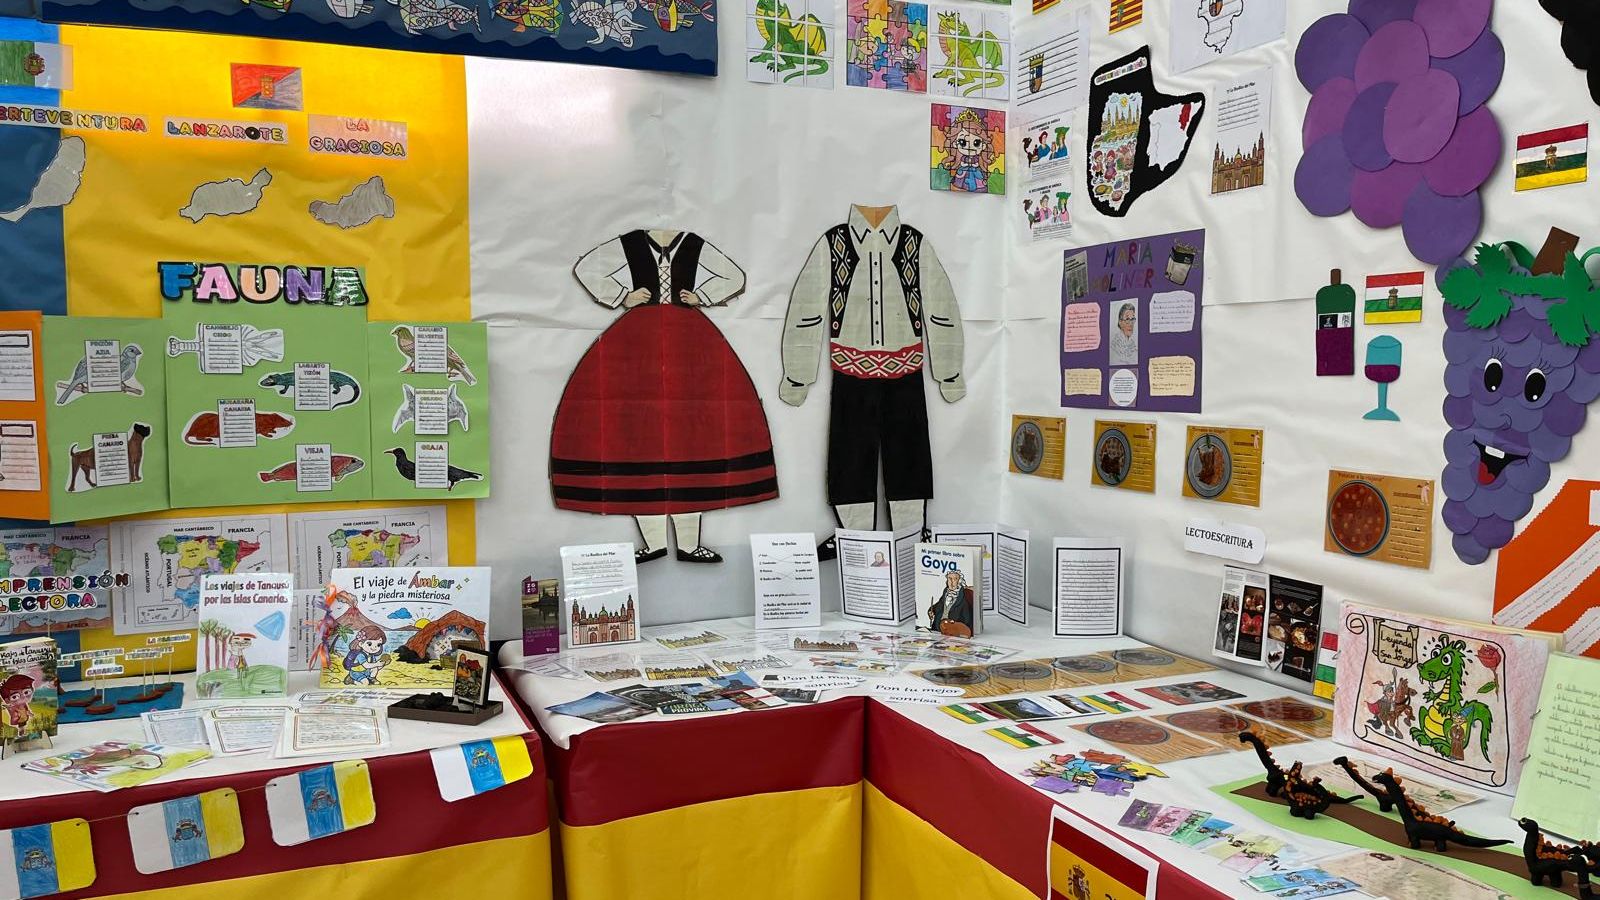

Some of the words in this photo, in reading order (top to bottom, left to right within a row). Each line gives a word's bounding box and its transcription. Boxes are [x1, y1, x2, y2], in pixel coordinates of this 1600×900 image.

[167, 121, 284, 142] LANZAROTE
[346, 117, 370, 132] LA
[309, 136, 406, 157] GRACIOSA
[158, 262, 369, 307] FAUNA
[304, 447, 324, 455] VIEJA
[1185, 526, 1253, 549] LECTOESCRITURA
[921, 555, 957, 573] Goya
[220, 581, 244, 592] viajes
[245, 581, 256, 590] de
[353, 576, 365, 590] El
[368, 576, 395, 590] viaje
[397, 576, 407, 585] de
[408, 571, 455, 589] Ámbar
[204, 595, 219, 606] por
[220, 594, 232, 603] las
[234, 594, 251, 604] Islas
[361, 592, 367, 601] y
[369, 590, 376, 599] la
[378, 589, 405, 600] piedra
[407, 589, 450, 600] misteriosa
[1381, 630, 1413, 648] Leyenda
